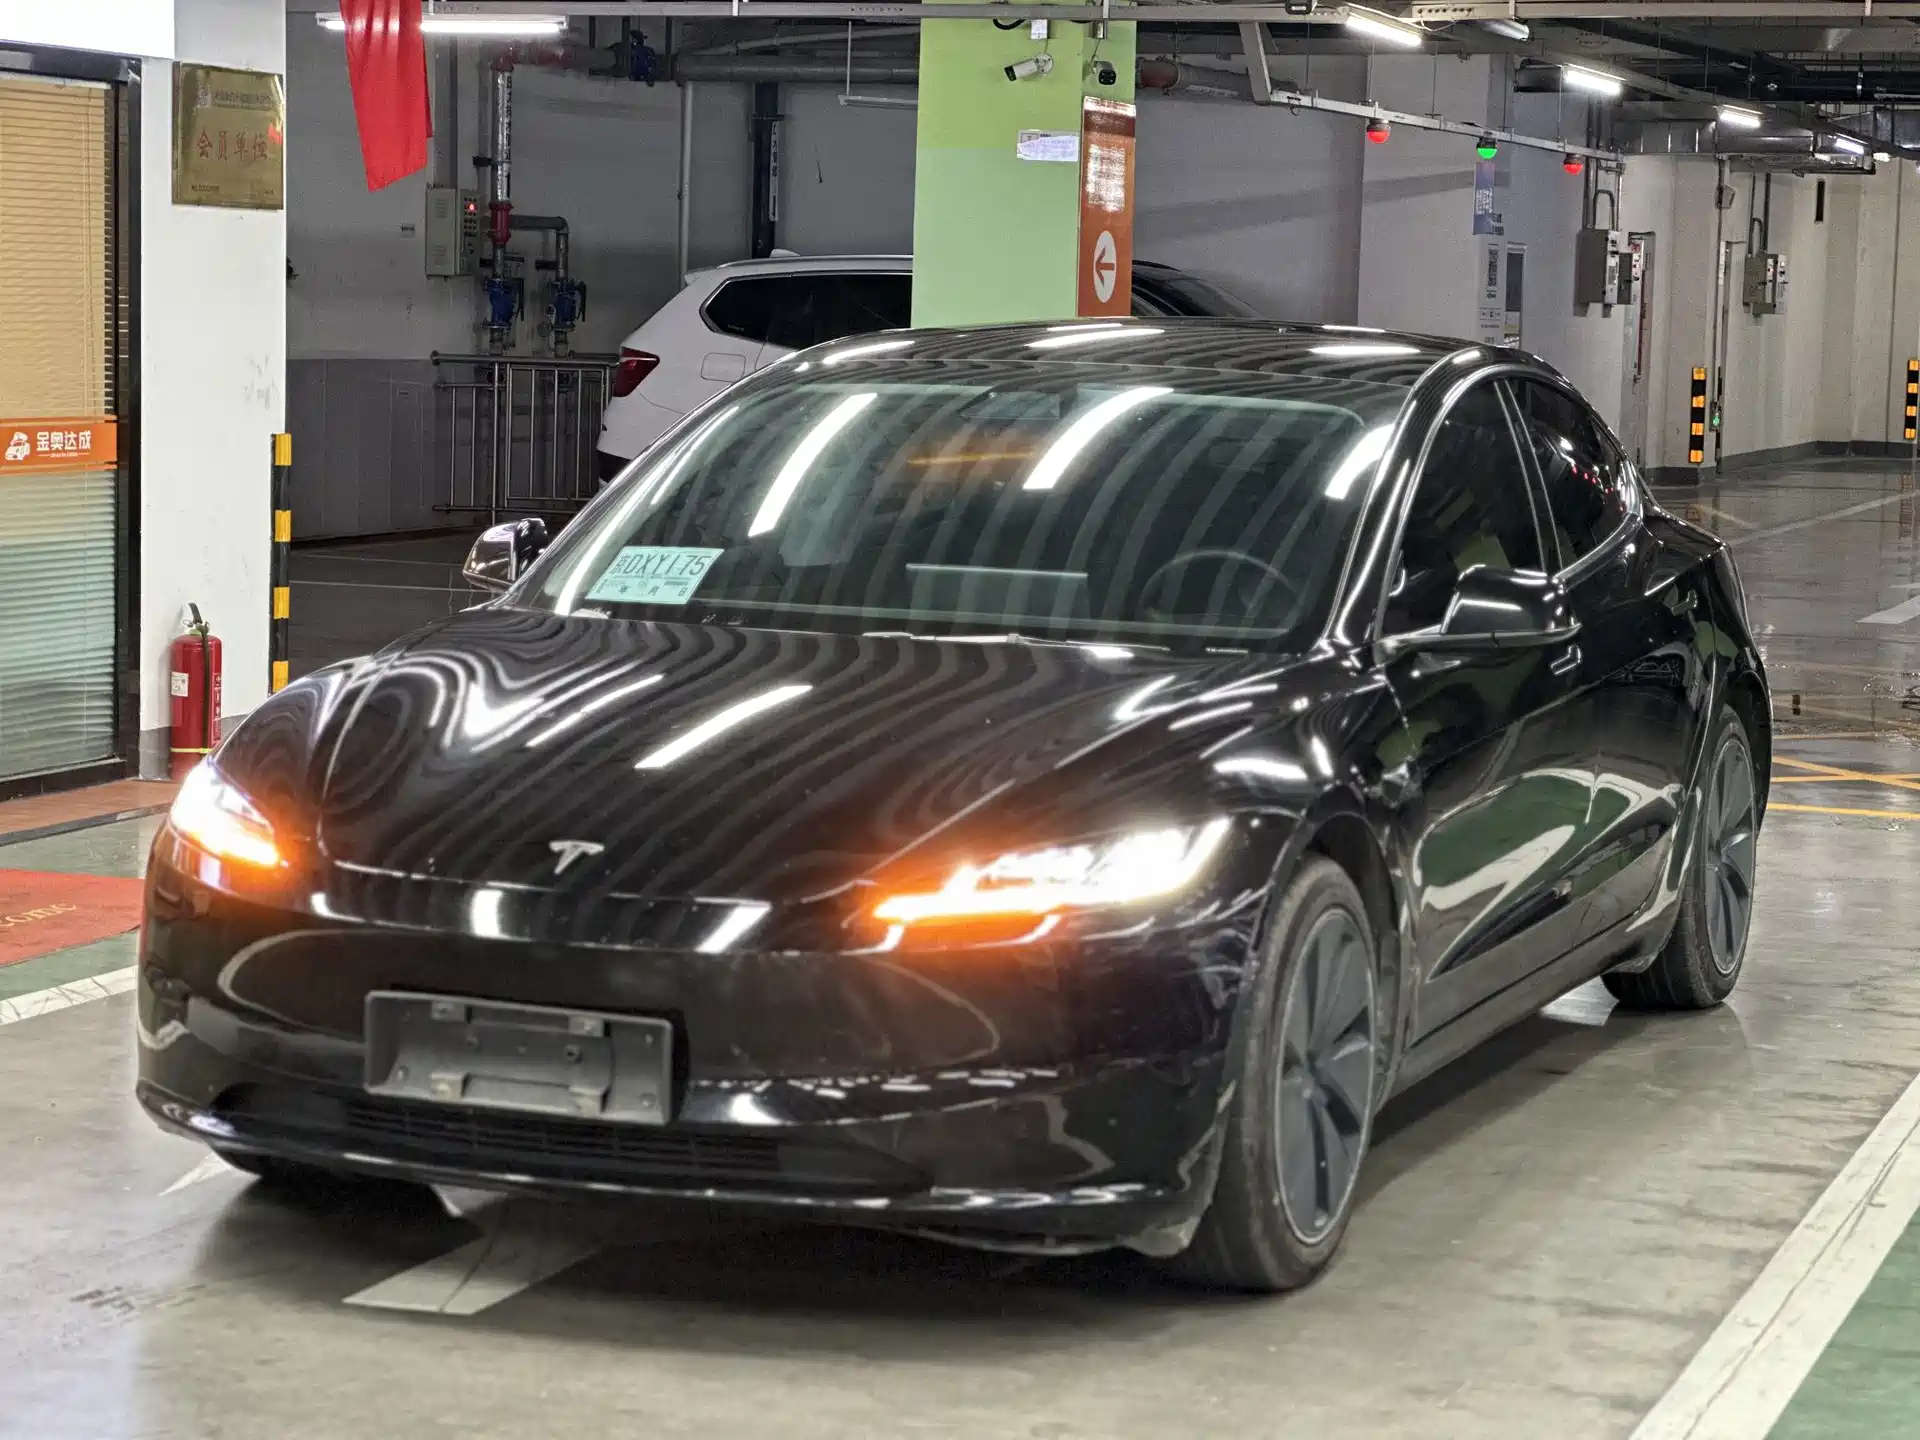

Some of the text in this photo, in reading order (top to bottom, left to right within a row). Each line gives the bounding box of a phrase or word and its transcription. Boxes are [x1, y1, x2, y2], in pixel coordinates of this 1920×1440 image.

[36, 430, 92, 451] 金奥达成
[610, 553, 712, 576] 京DXY175
